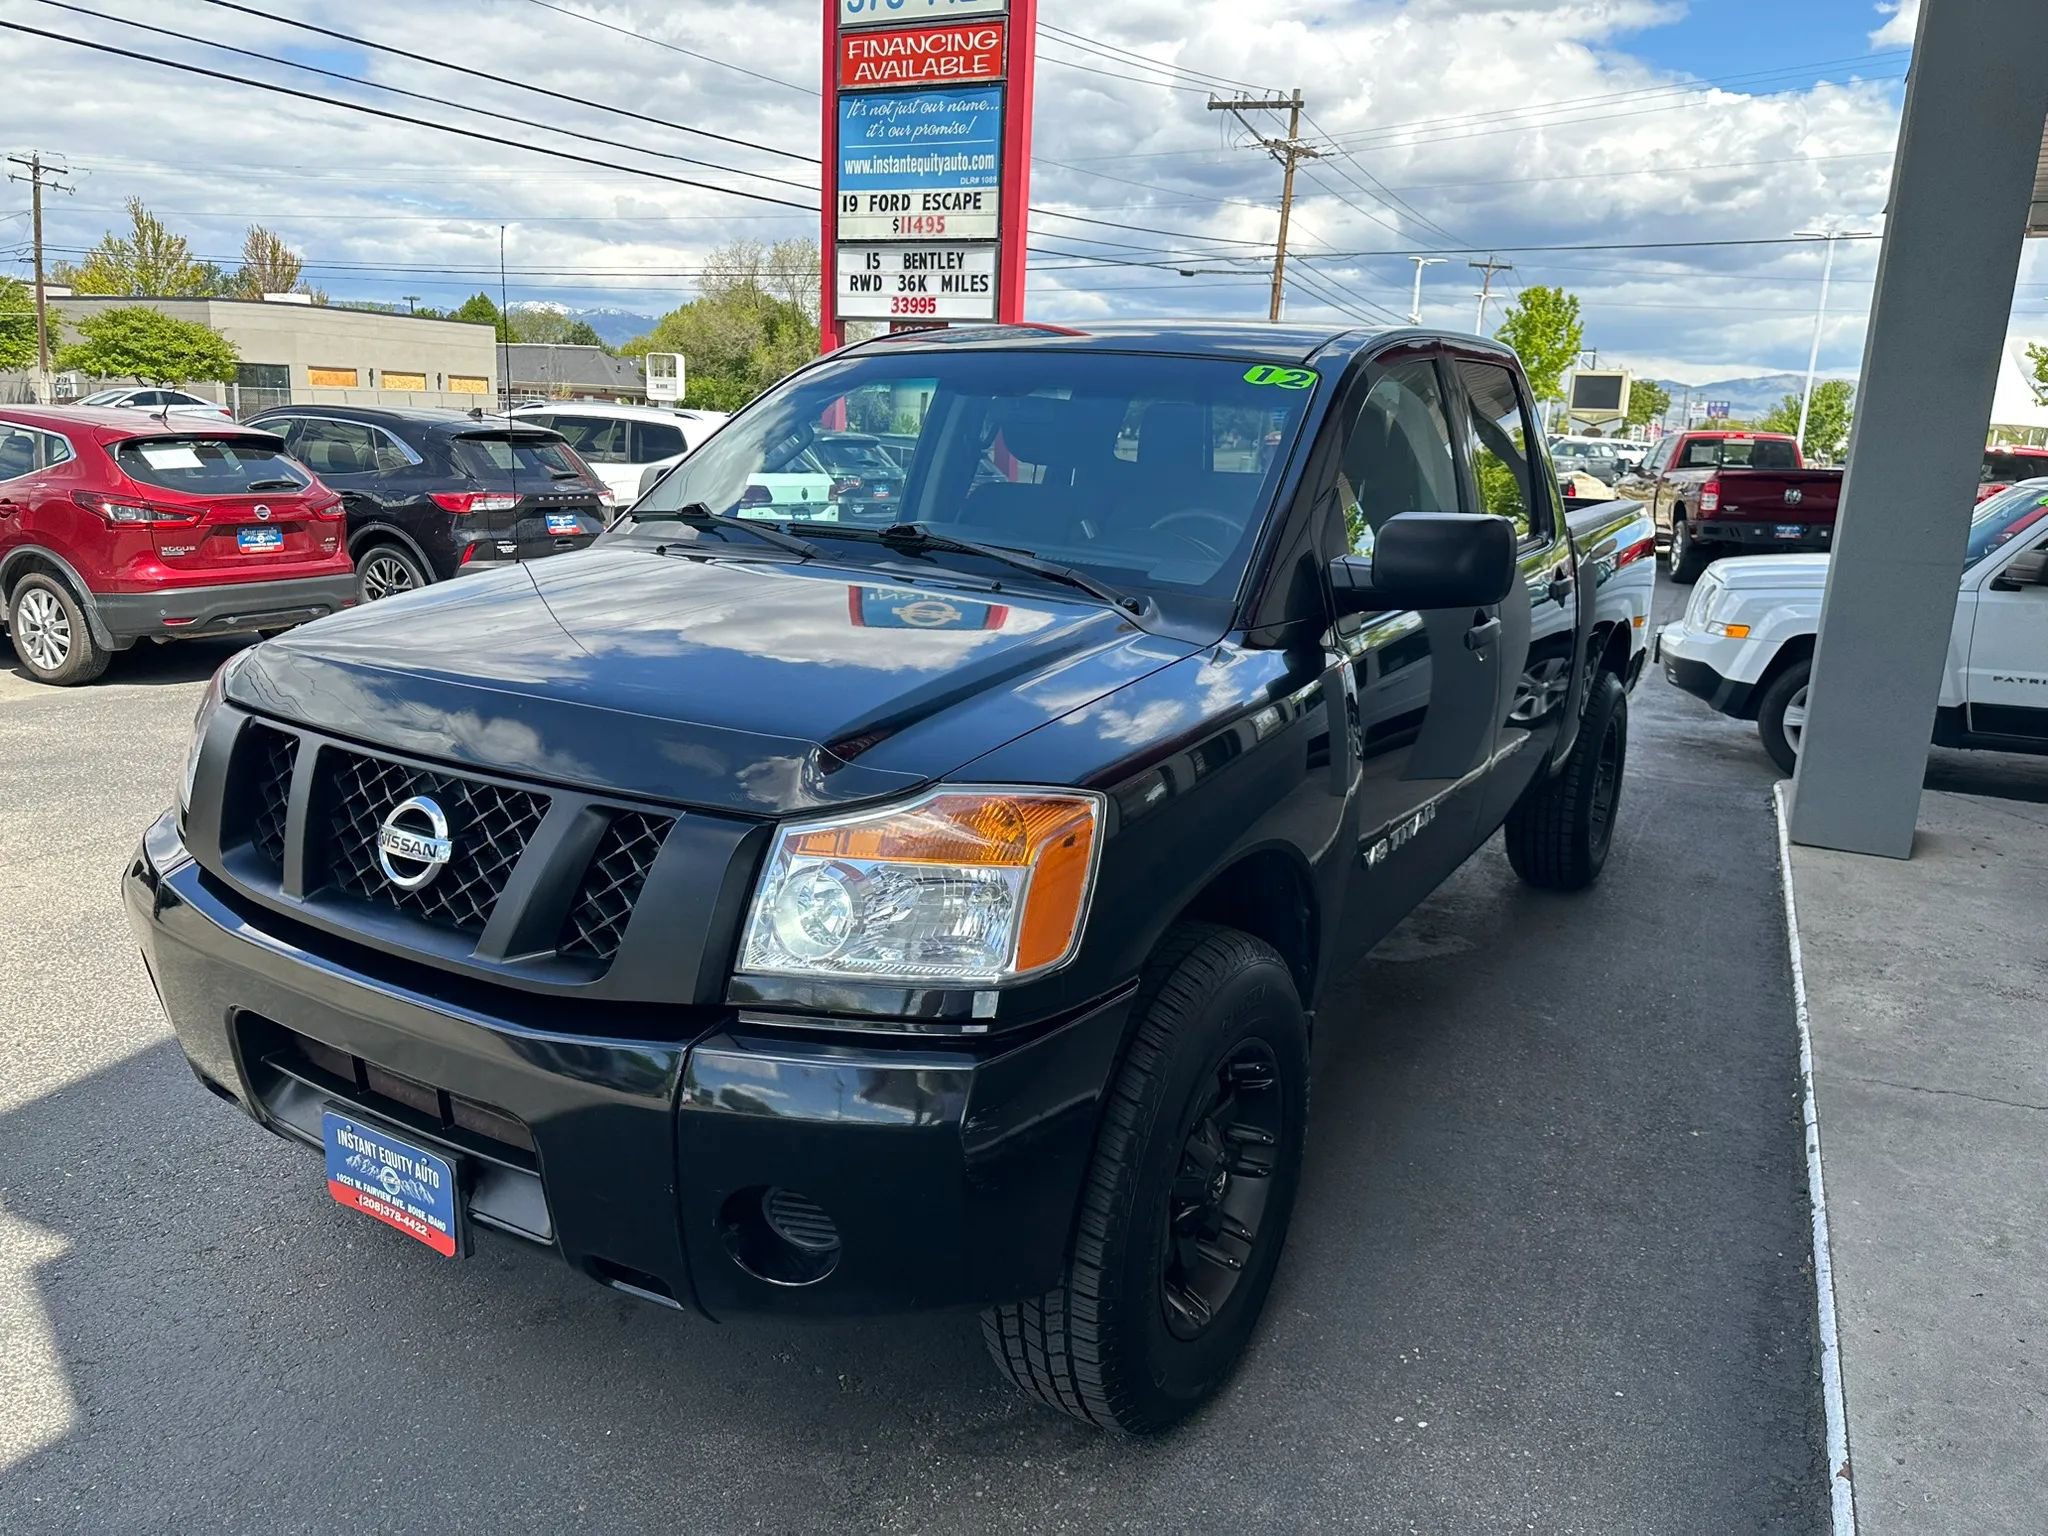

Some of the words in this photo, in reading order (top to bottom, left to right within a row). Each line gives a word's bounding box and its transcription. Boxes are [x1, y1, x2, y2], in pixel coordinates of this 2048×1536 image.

[848, 30, 999, 59] FINANCING
[854, 54, 991, 81] AVAILABLE
[846, 98, 867, 119] It's
[869, 100, 893, 117] not
[887, 99, 921, 123] just
[920, 101, 945, 114] our
[946, 99, 999, 113] name...
[866, 120, 885, 138] it's
[888, 125, 912, 138] our
[910, 115, 978, 142] promise!
[844, 152, 995, 176] www.instantequityauto.com
[842, 195, 858, 213] 19
[869, 194, 911, 212] FORD
[922, 192, 982, 211] ESCAPE
[892, 216, 945, 234] $11495
[866, 252, 881, 270] 15
[903, 252, 965, 270] BENTLEY
[850, 274, 883, 292] RWD
[897, 275, 928, 292] 36K
[941, 274, 989, 293] MILES
[891, 297, 936, 314] 33995
[380, 831, 438, 858] NISSAN
[336, 1128, 376, 1159] INSTANT
[379, 1145, 413, 1175] EQUITY
[415, 1161, 440, 1189] AUTO
[335, 1172, 354, 1188] 10221
[362, 1182, 392, 1202] FAIRVIEW
[391, 1196, 406, 1211] AVE.
[407, 1203, 427, 1222] BOISE,
[428, 1214, 447, 1232] IDAHO
[358, 1194, 428, 1237] (208)378-4422
